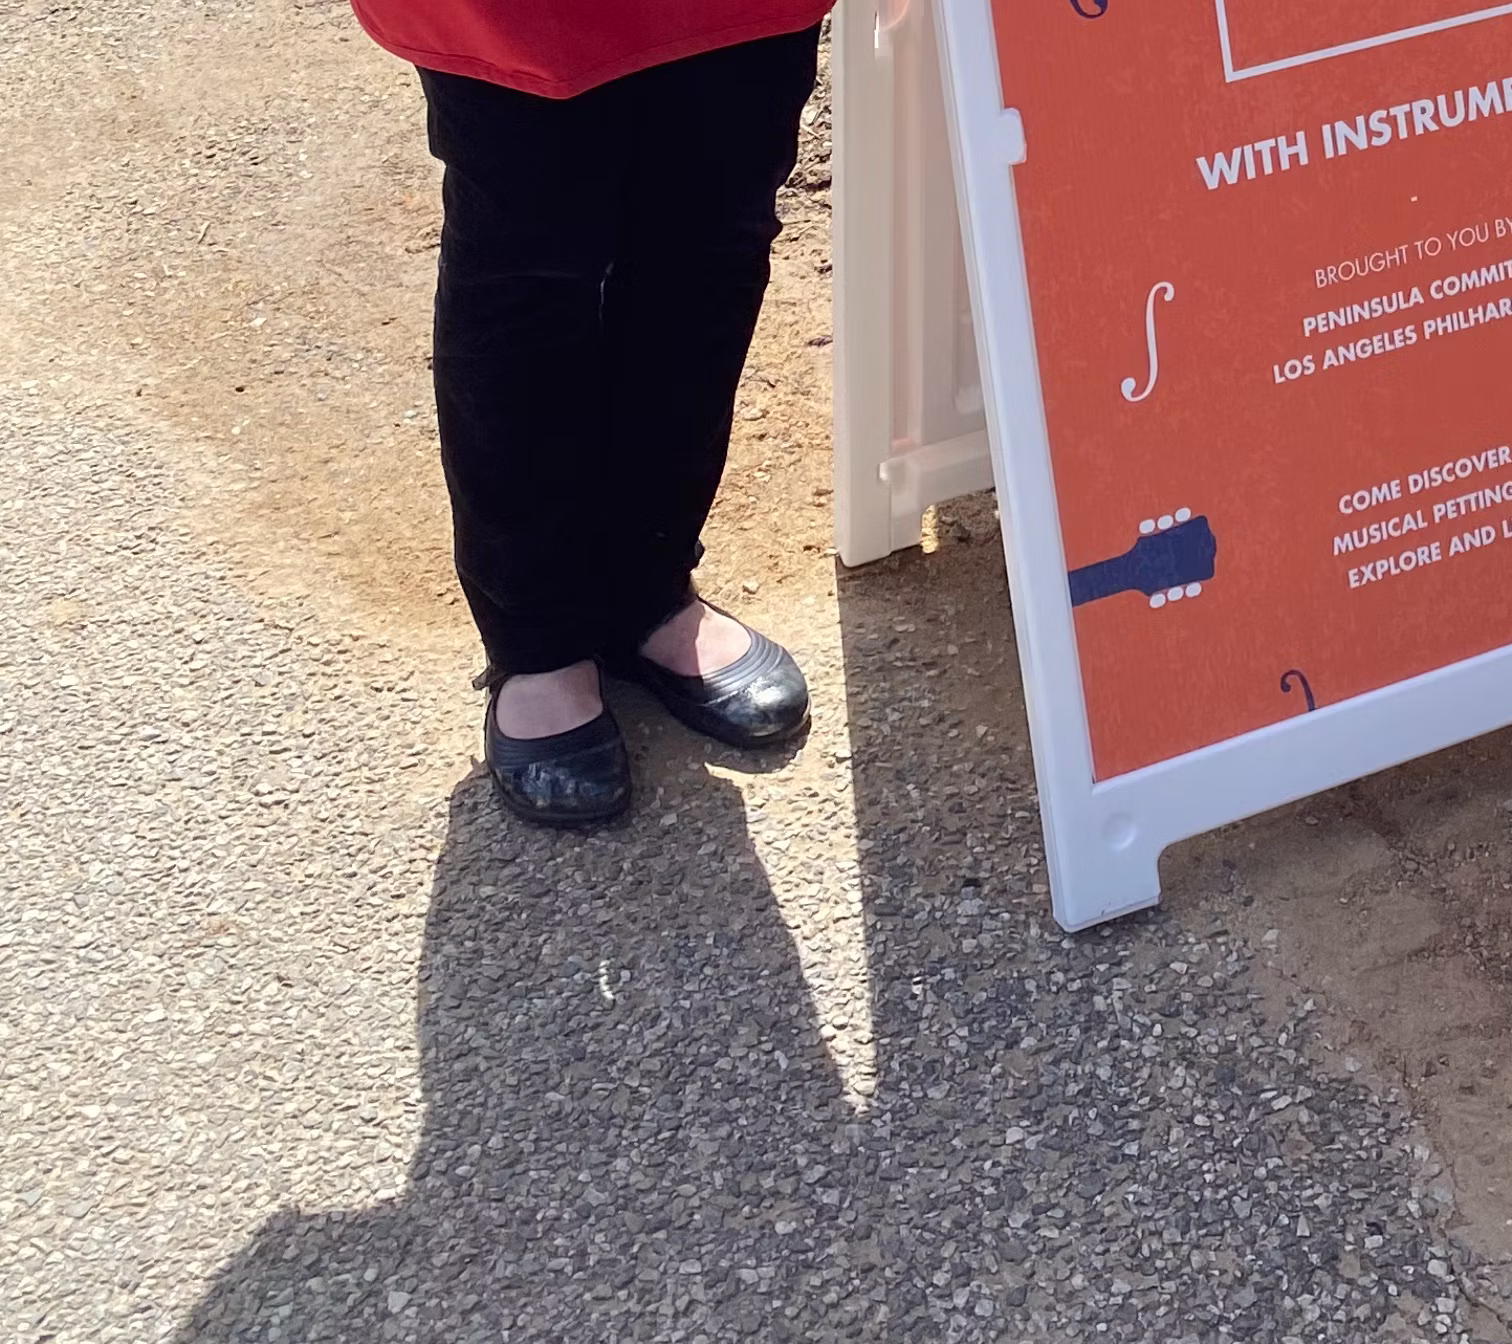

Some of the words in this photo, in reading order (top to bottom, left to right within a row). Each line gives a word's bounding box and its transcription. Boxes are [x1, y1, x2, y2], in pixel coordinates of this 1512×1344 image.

[1195, 130, 1309, 191] WITH
[1315, 244, 1409, 289] BROUGHT
[1414, 237, 1442, 260] TO
[1446, 223, 1489, 250] YOU
[1303, 286, 1425, 337] PENINSULA
[1273, 354, 1316, 384] LOS
[1322, 324, 1418, 370] ANGELES
[1338, 479, 1402, 515] COME
[1407, 445, 1512, 494] DISCOVER
[1333, 509, 1429, 556] MUSICAL
[1348, 541, 1442, 589] EXPLORE
[1449, 525, 1496, 557] AND
